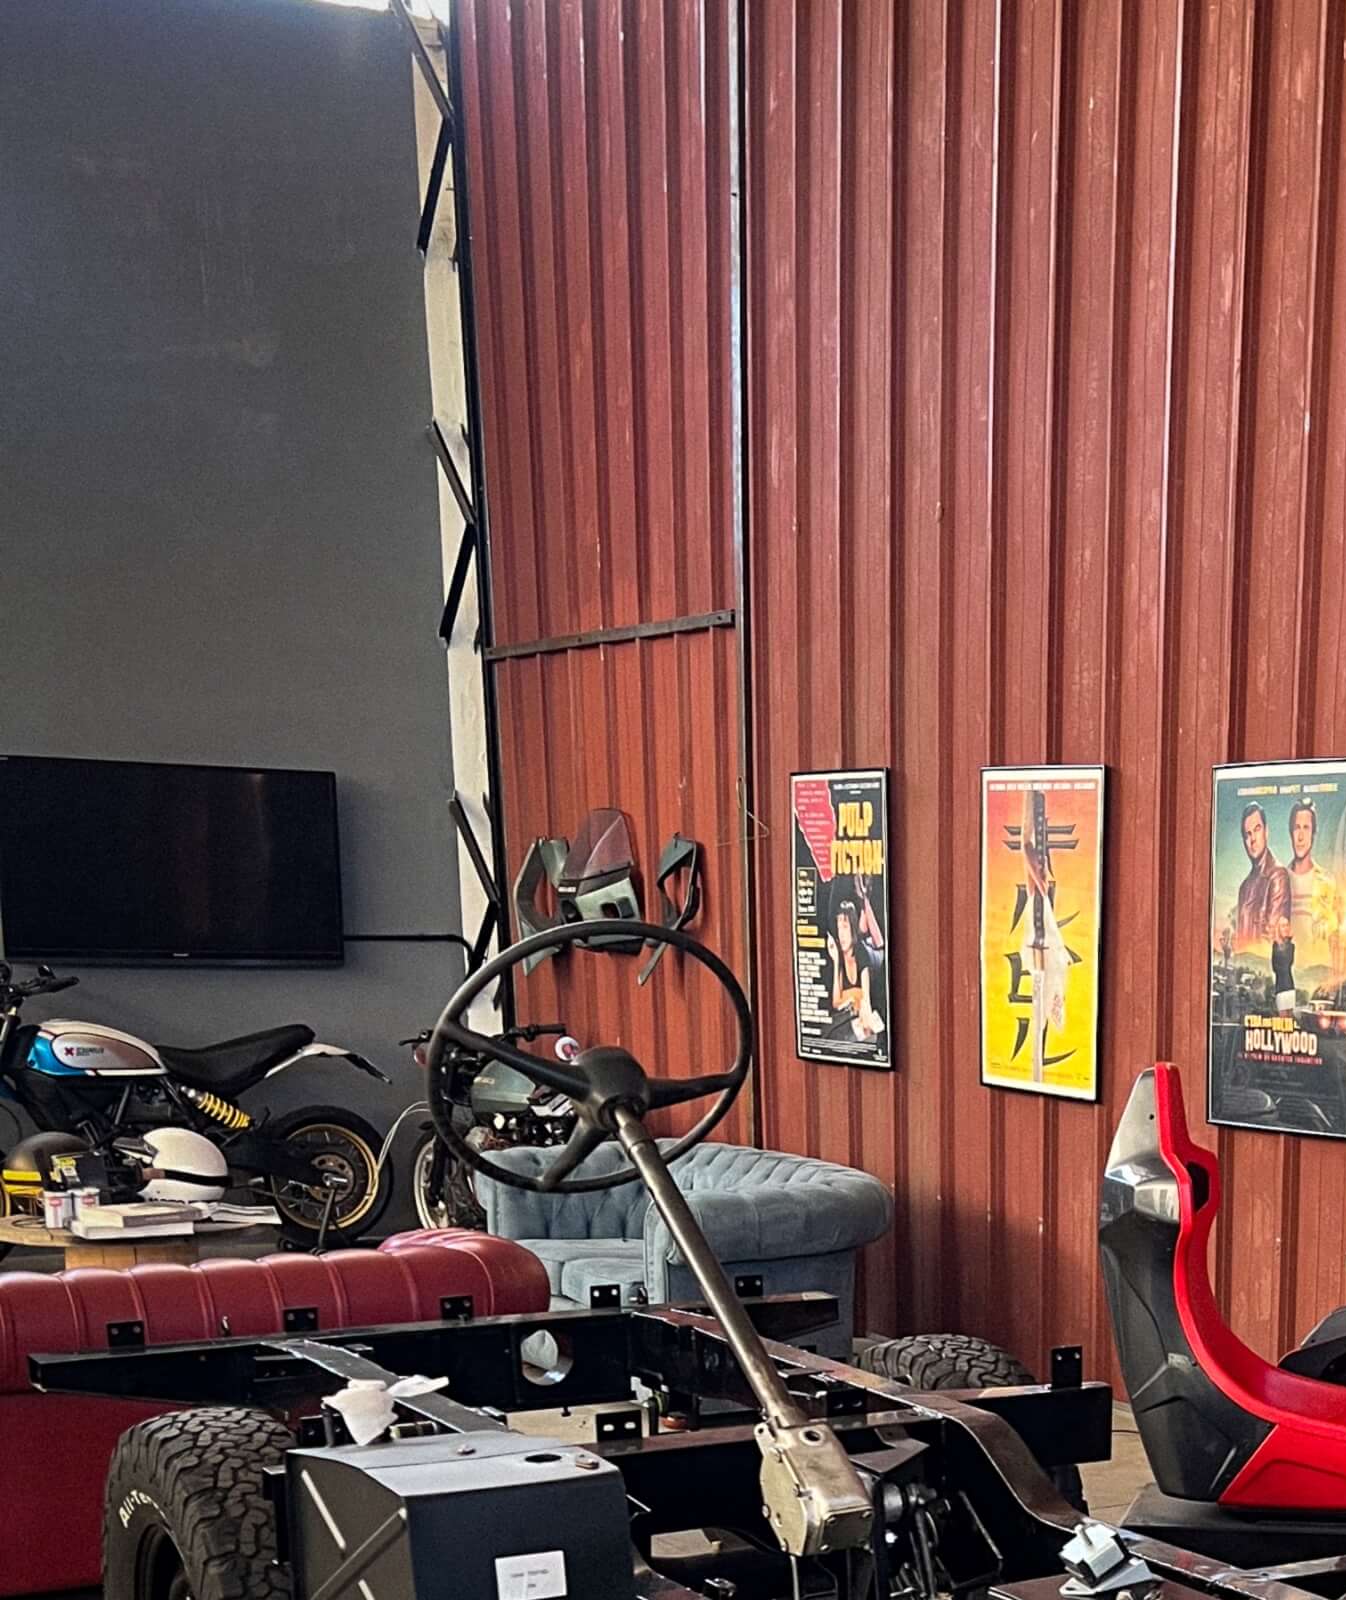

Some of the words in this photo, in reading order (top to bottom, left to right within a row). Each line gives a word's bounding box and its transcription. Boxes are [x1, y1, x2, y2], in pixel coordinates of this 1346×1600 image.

[838, 800, 873, 837] PULP
[830, 840, 883, 876] FICTION
[1245, 1028, 1318, 1056] HOLLYWOOD
